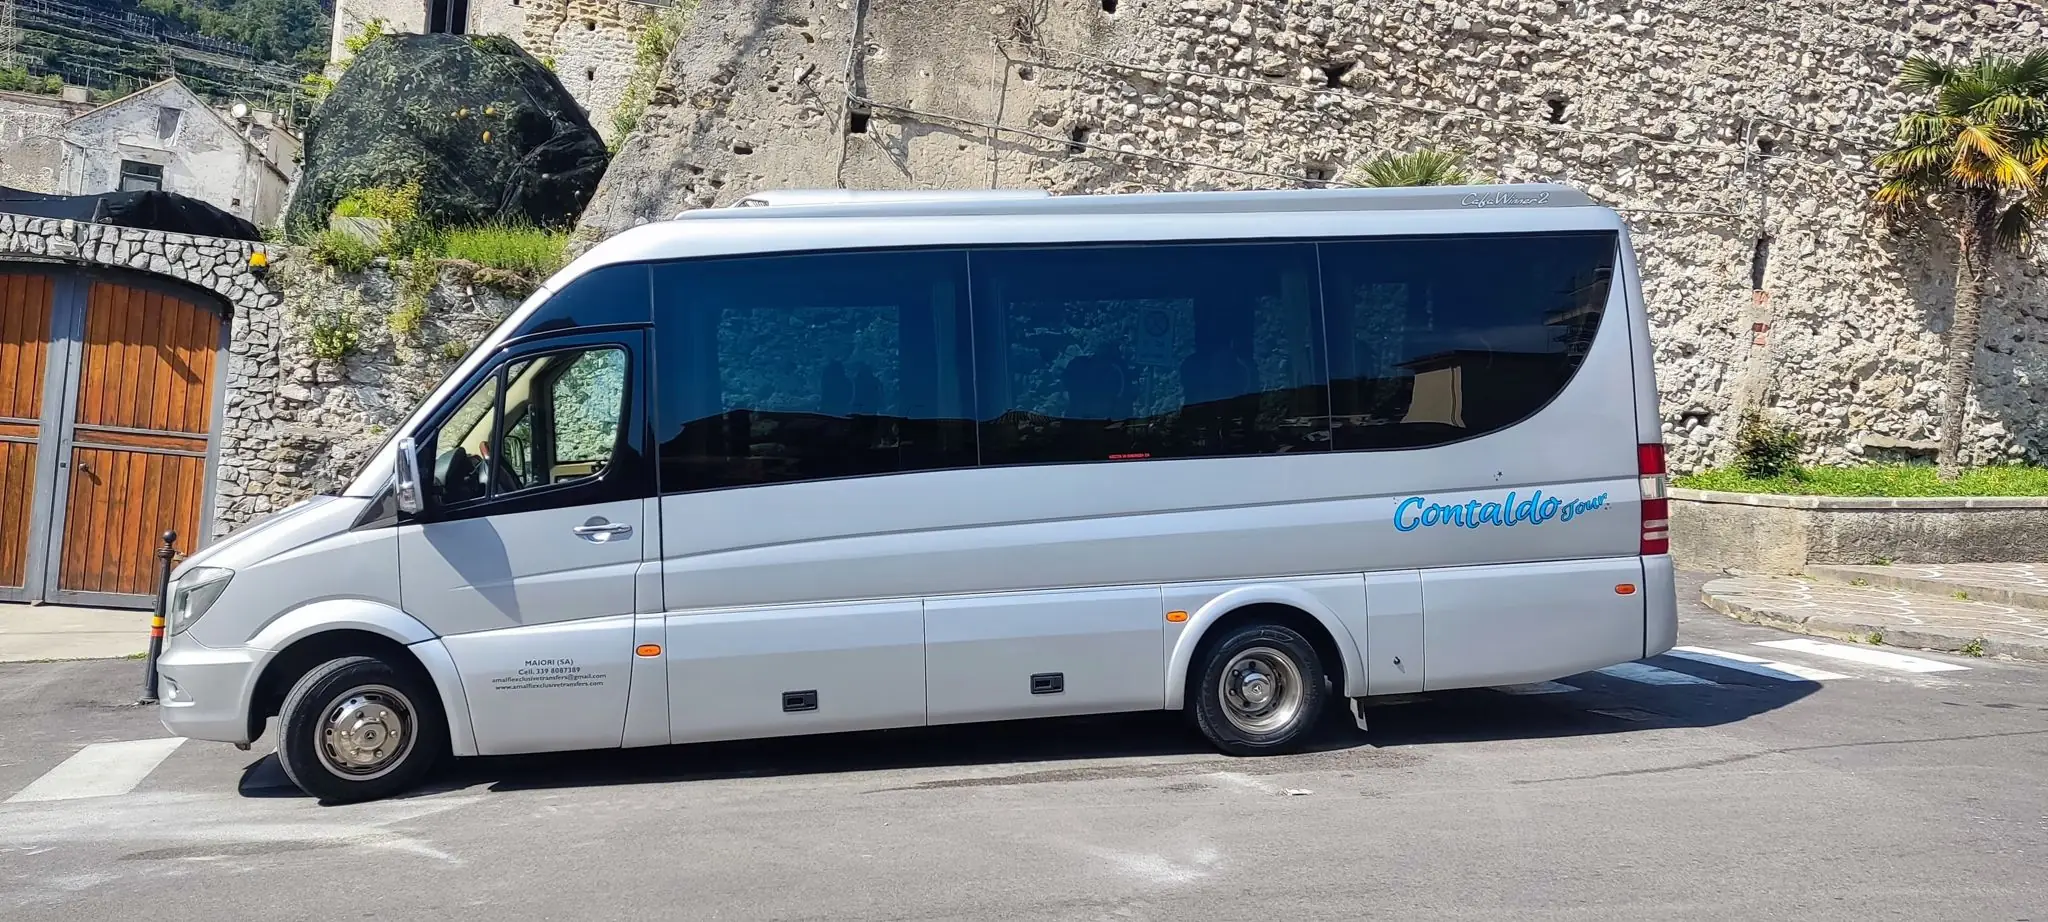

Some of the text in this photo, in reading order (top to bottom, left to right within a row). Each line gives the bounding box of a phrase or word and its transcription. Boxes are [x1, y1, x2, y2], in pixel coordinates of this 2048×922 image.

[1393, 490, 1607, 532] Contaldo Tour
[525, 659, 555, 667] MAIORI
[518, 668, 535, 676] Cell.
